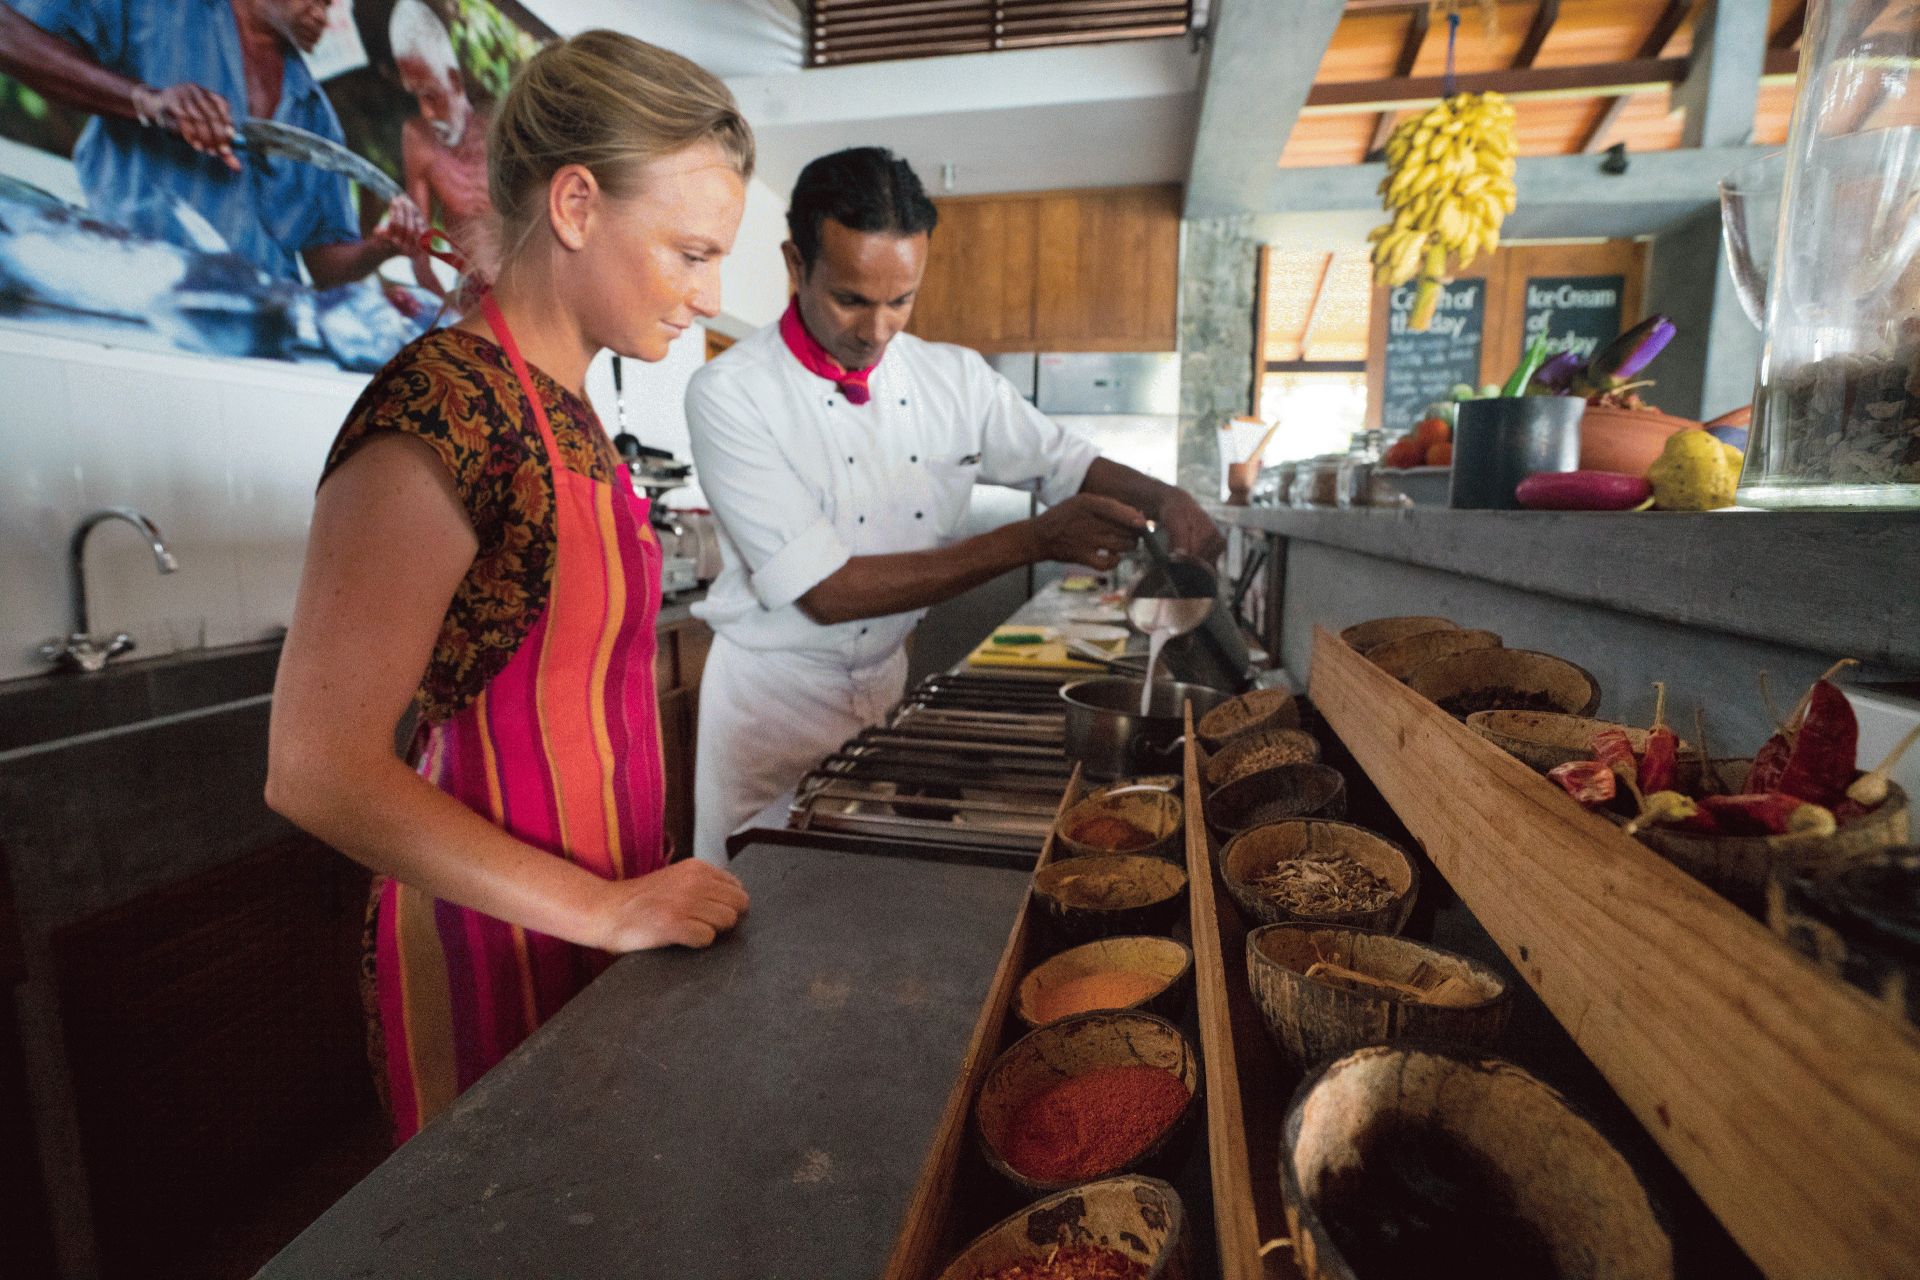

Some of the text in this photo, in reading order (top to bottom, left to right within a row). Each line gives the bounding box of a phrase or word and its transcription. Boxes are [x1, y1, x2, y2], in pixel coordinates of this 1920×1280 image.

[1391, 286, 1477, 311] Cah of
[1527, 284, 1616, 309] Ice Cream
[1526, 309, 1553, 332] of
